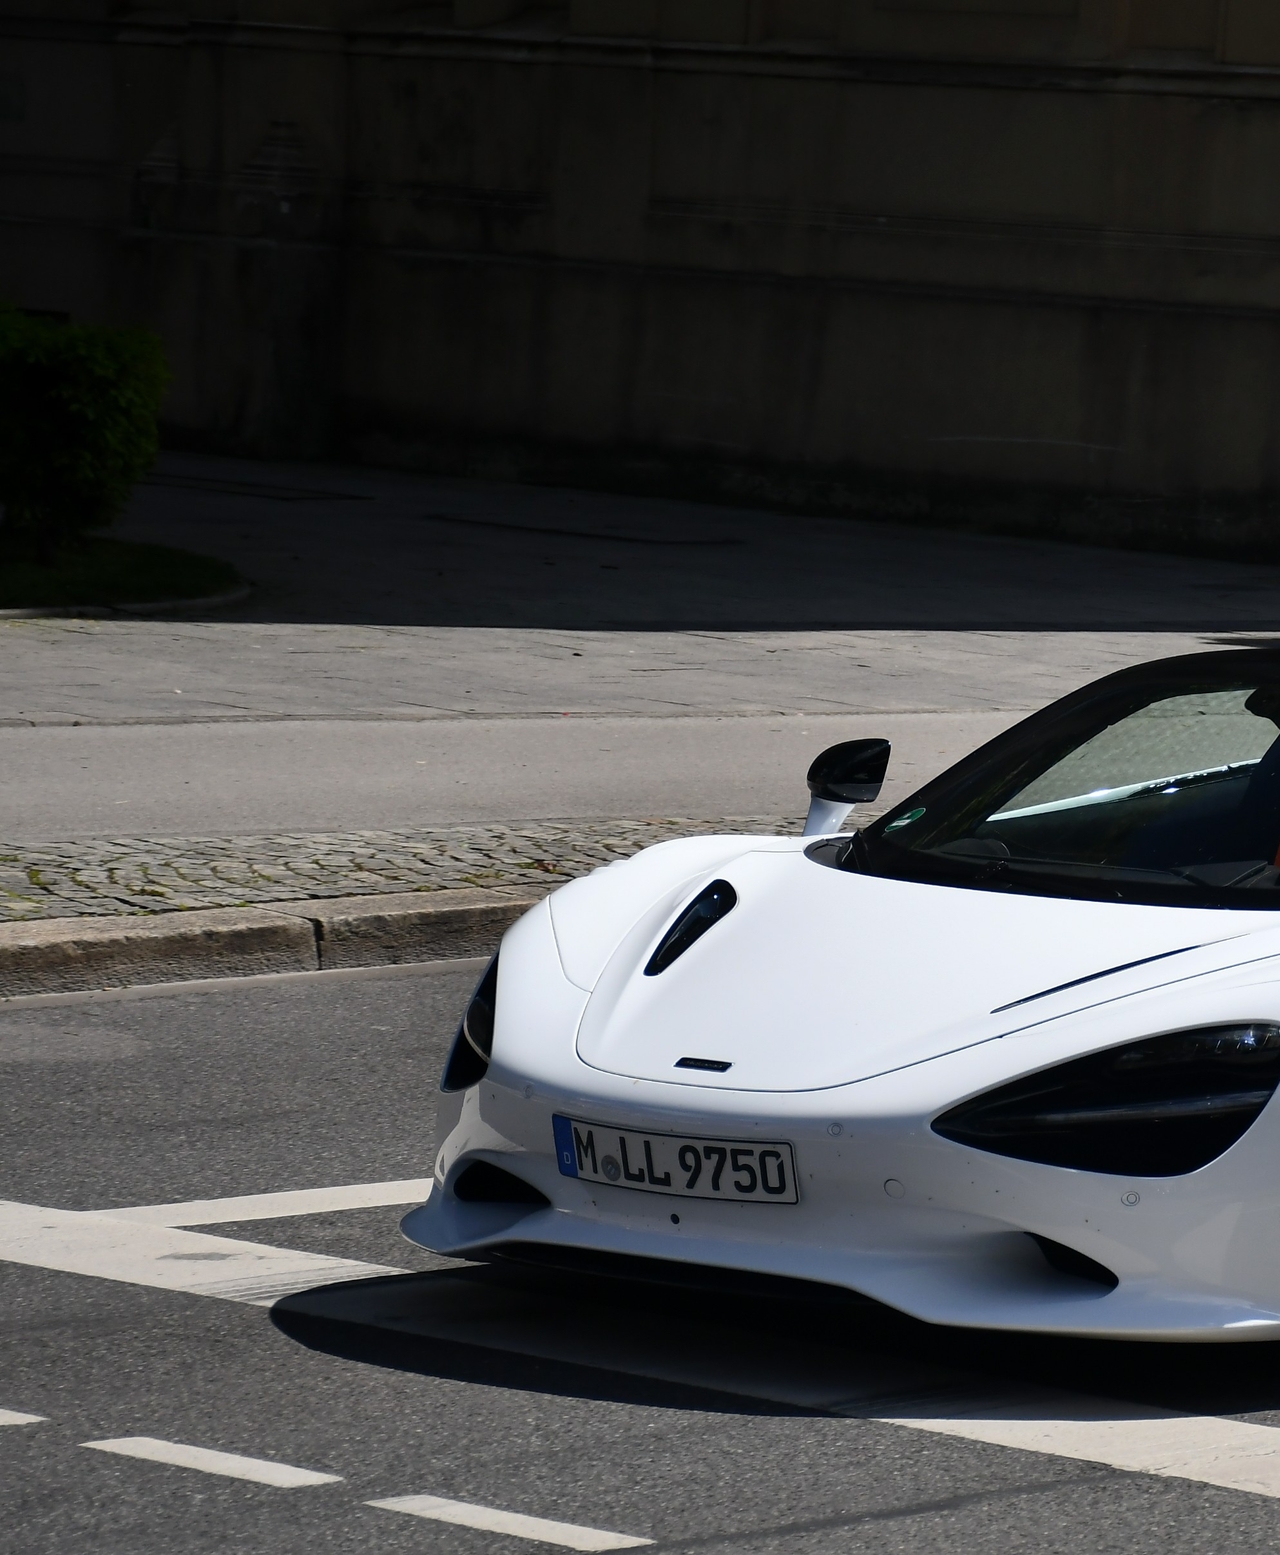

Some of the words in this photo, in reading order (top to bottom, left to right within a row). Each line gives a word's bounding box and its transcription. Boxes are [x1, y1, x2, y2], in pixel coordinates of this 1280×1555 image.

[573, 1126, 598, 1175] M
[619, 1136, 672, 1187] LL
[678, 1144, 787, 1195] 9750
